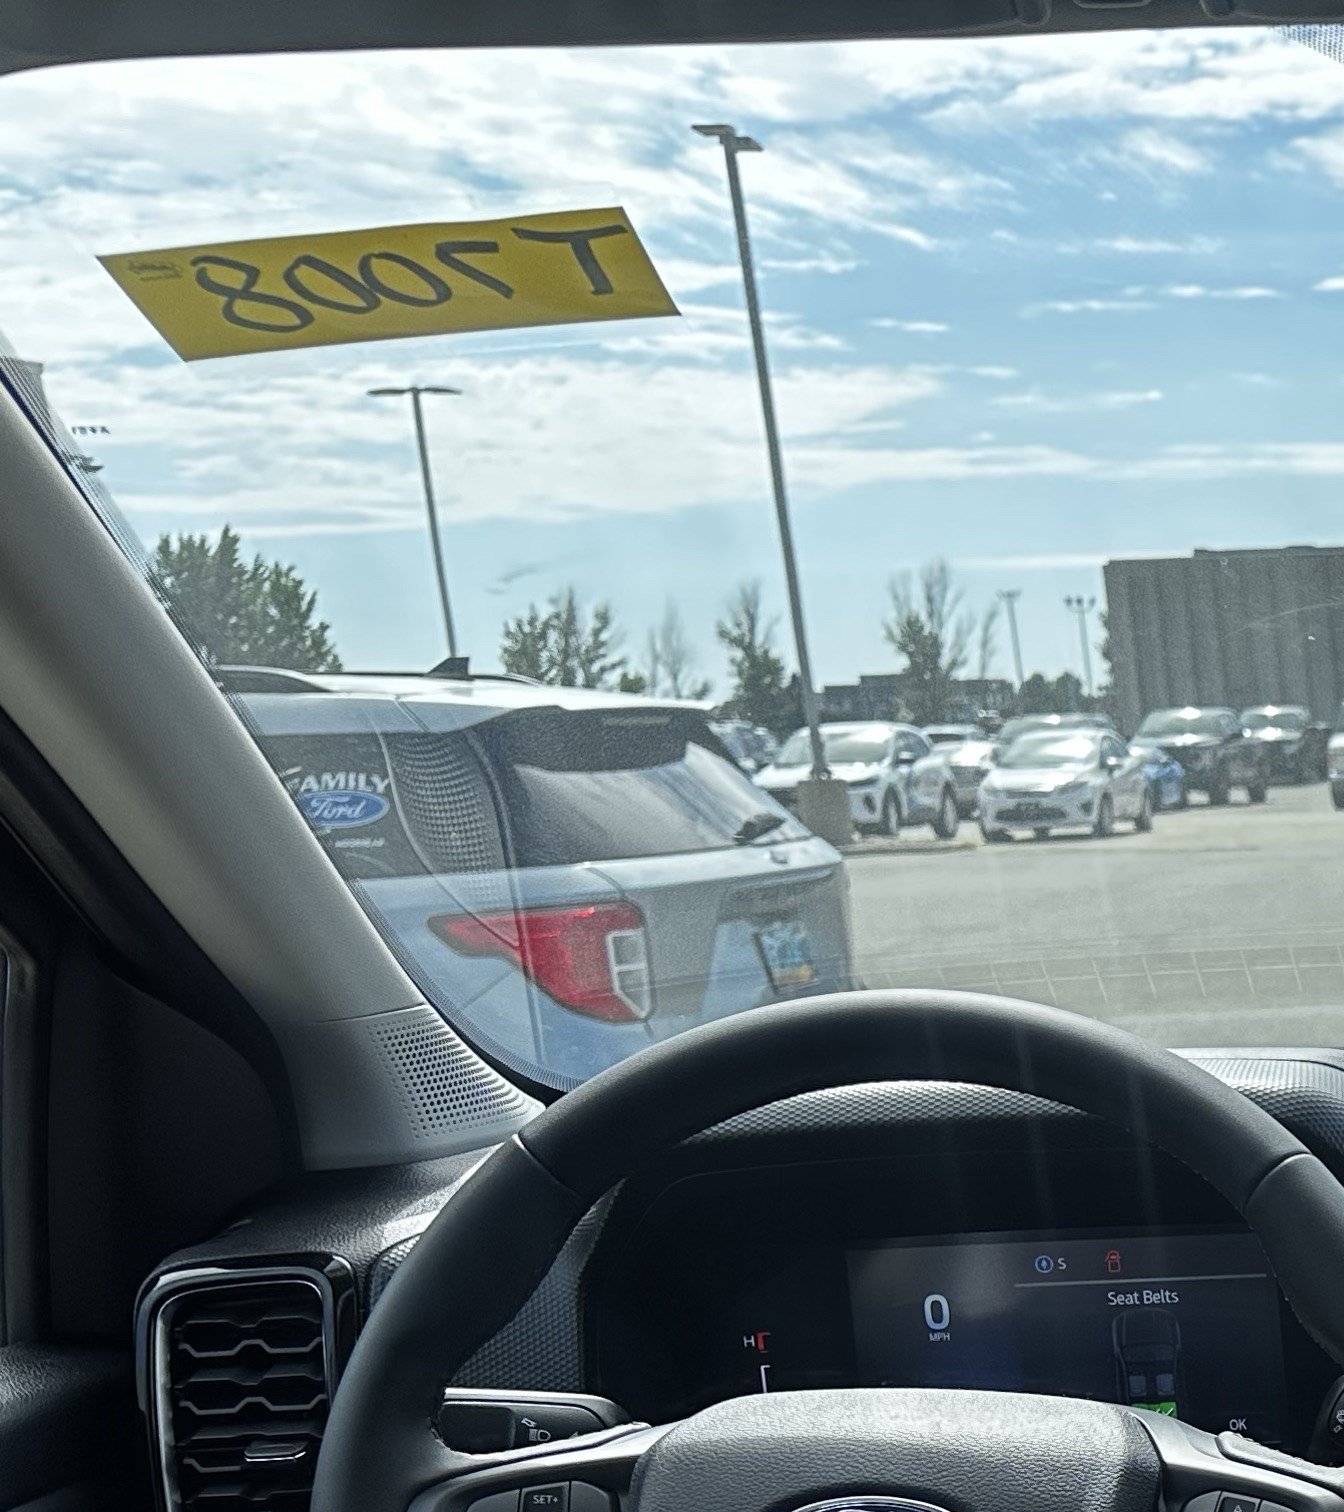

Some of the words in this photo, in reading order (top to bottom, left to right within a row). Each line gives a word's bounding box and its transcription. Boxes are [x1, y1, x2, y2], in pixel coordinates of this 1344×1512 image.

[290, 771, 391, 793] AMILY
[310, 796, 367, 819] Ford
[1056, 1256, 1068, 1270] S
[1107, 1290, 1139, 1307] Seat
[1142, 1288, 1180, 1305] Belts
[923, 1292, 952, 1332] 0
[741, 1335, 756, 1350] H
[928, 1331, 953, 1343] MPH
[1229, 1418, 1248, 1431] OK
